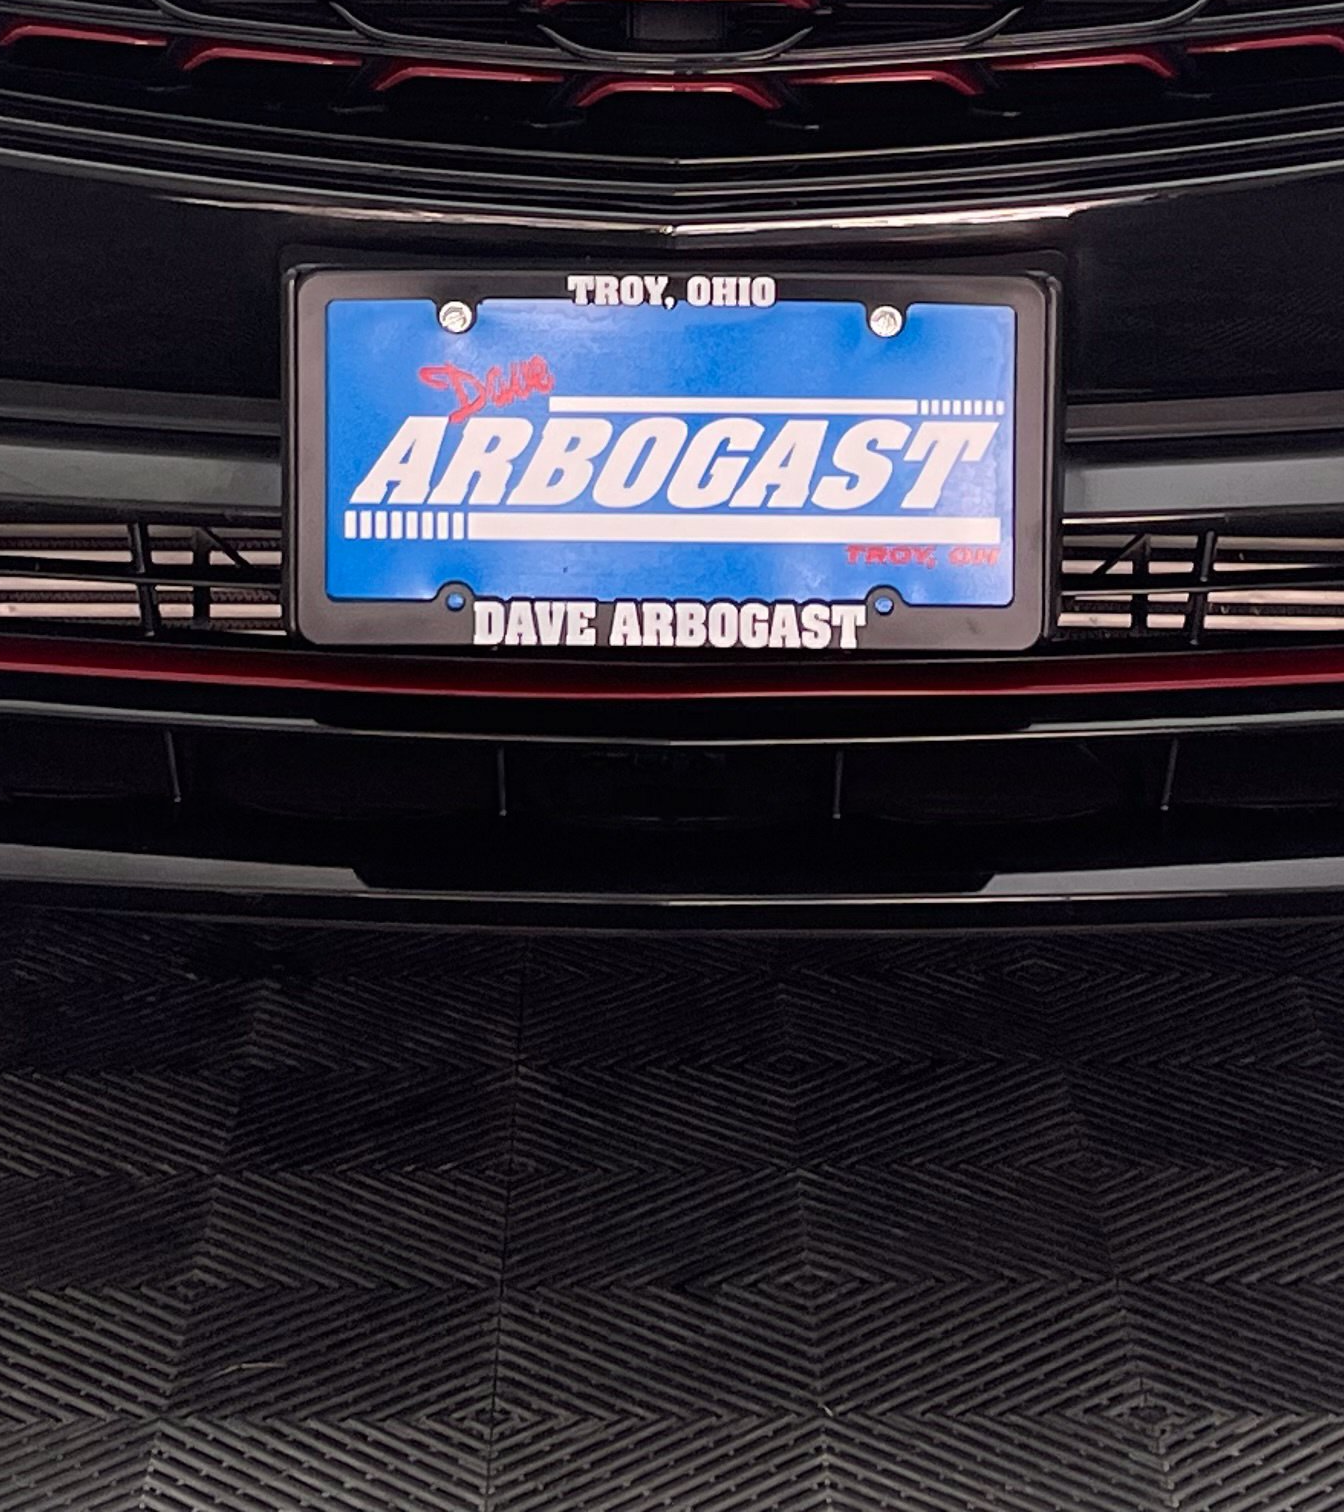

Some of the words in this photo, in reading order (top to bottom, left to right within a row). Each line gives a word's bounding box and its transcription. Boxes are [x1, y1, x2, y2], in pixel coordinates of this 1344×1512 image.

[567, 274, 676, 309] TROY,
[687, 275, 777, 307] OHIO
[350, 416, 1000, 510] ARBOGAST
[845, 544, 937, 570] TROY,
[472, 600, 597, 646] DAVE
[608, 602, 867, 650] ARBOGAST
